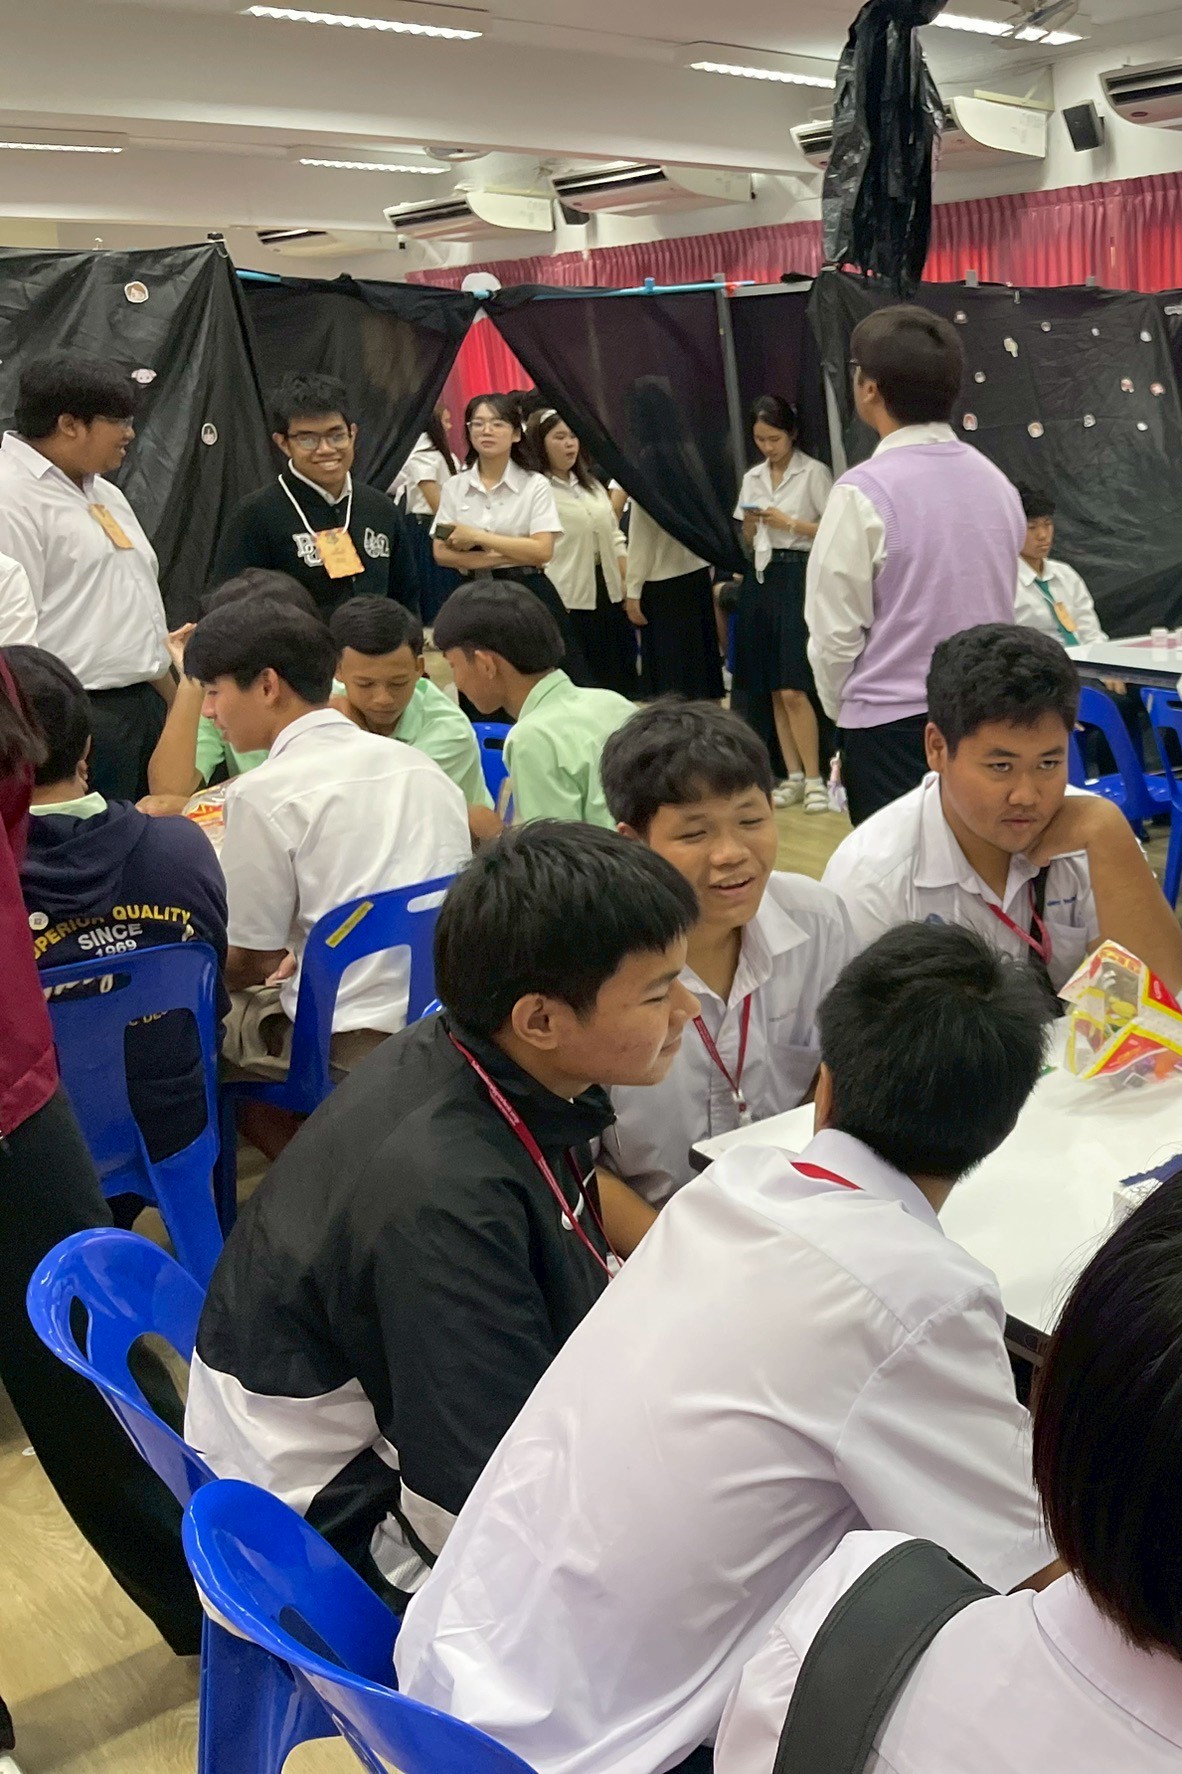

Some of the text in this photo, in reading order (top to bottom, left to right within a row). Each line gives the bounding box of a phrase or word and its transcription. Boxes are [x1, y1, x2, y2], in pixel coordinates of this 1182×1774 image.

[112, 904, 191, 925] QUALITY
[78, 923, 143, 950] SINCE
[95, 939, 137, 957] 1969
